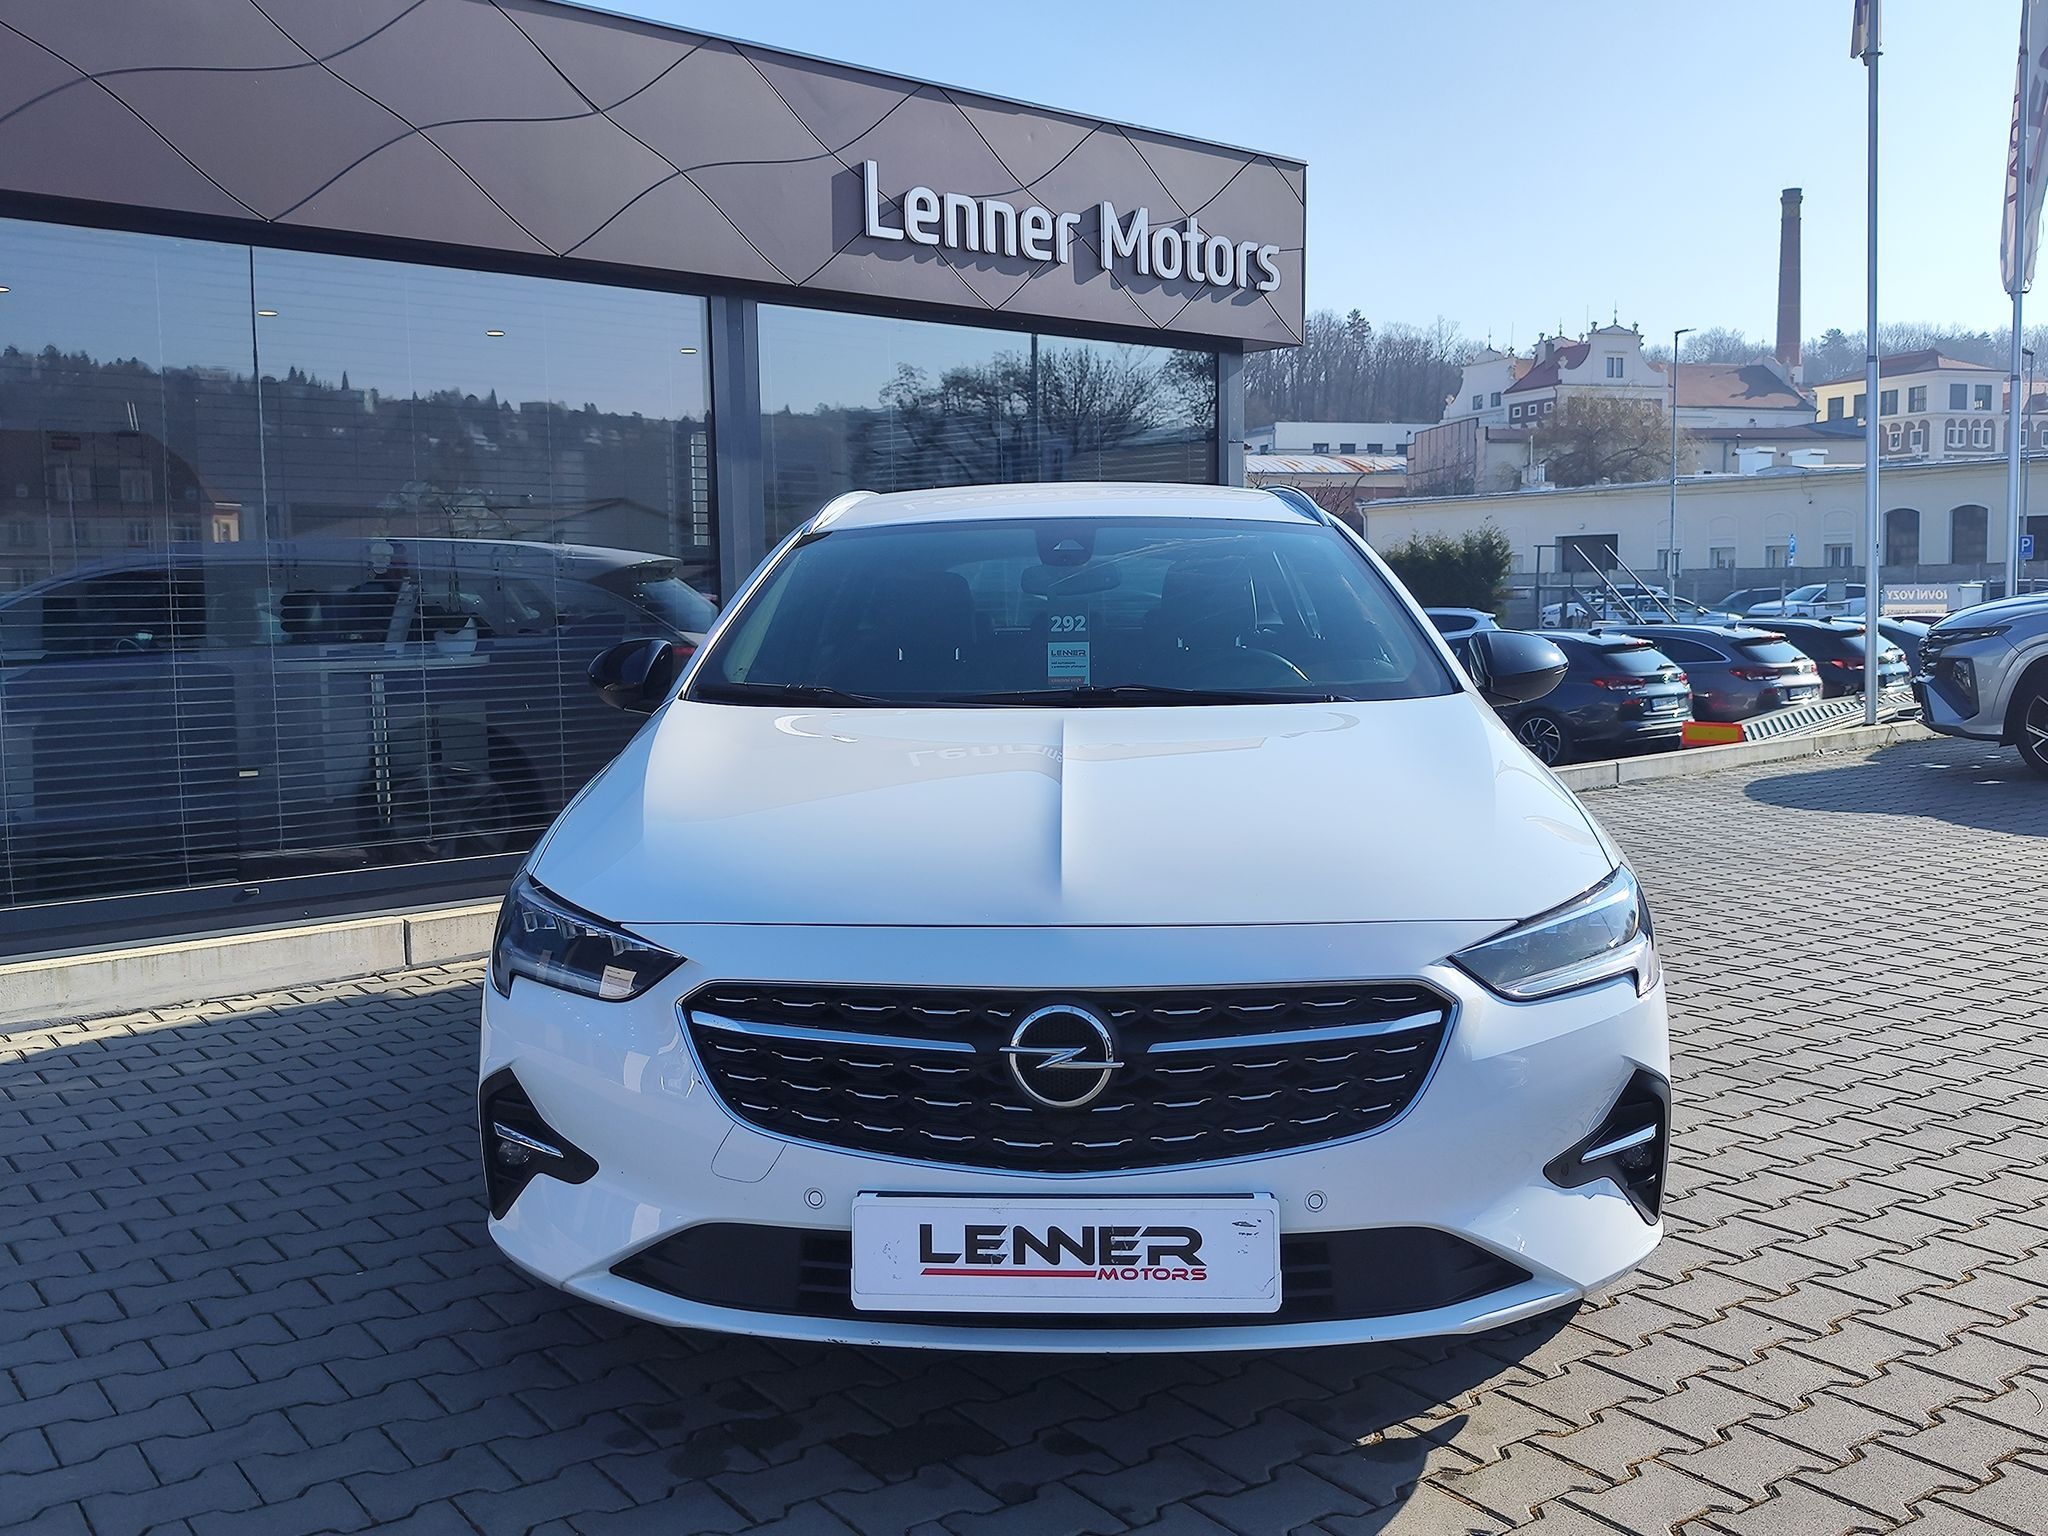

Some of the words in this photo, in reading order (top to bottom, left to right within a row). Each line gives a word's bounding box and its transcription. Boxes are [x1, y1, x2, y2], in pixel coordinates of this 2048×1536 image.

[863, 160, 1081, 265] Lenner
[1100, 200, 1282, 292] Motors
[2021, 537, 2031, 552] P
[1050, 615, 1087, 632] 292
[918, 1223, 1208, 1267] LENNER
[1096, 1267, 1208, 1282] MOTORS
